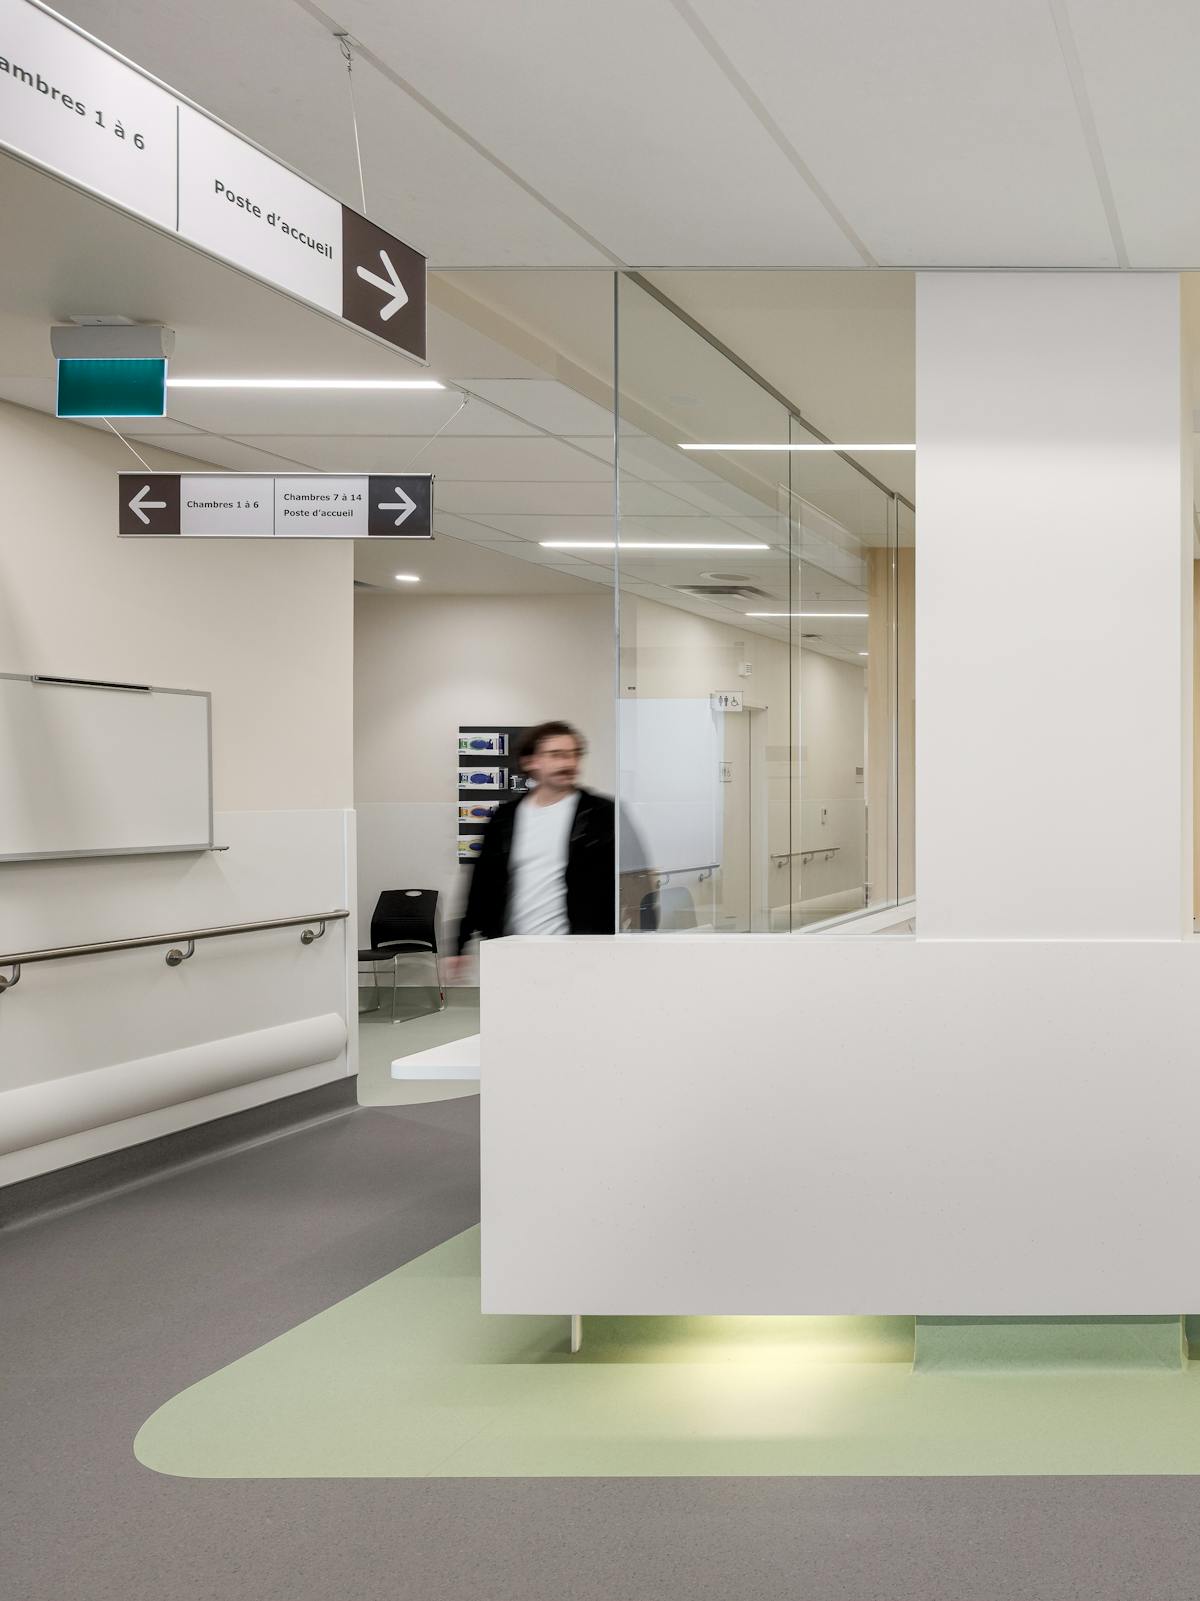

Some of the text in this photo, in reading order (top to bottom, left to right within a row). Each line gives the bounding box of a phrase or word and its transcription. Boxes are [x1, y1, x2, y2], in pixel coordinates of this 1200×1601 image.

[0, 56, 146, 151] ambres 1 à 6
[214, 179, 262, 219] Poste
[283, 493, 362, 502] Chambres 7 à 14
[186, 500, 260, 509] Chambres 1 à 6
[283, 509, 310, 517] Poste
